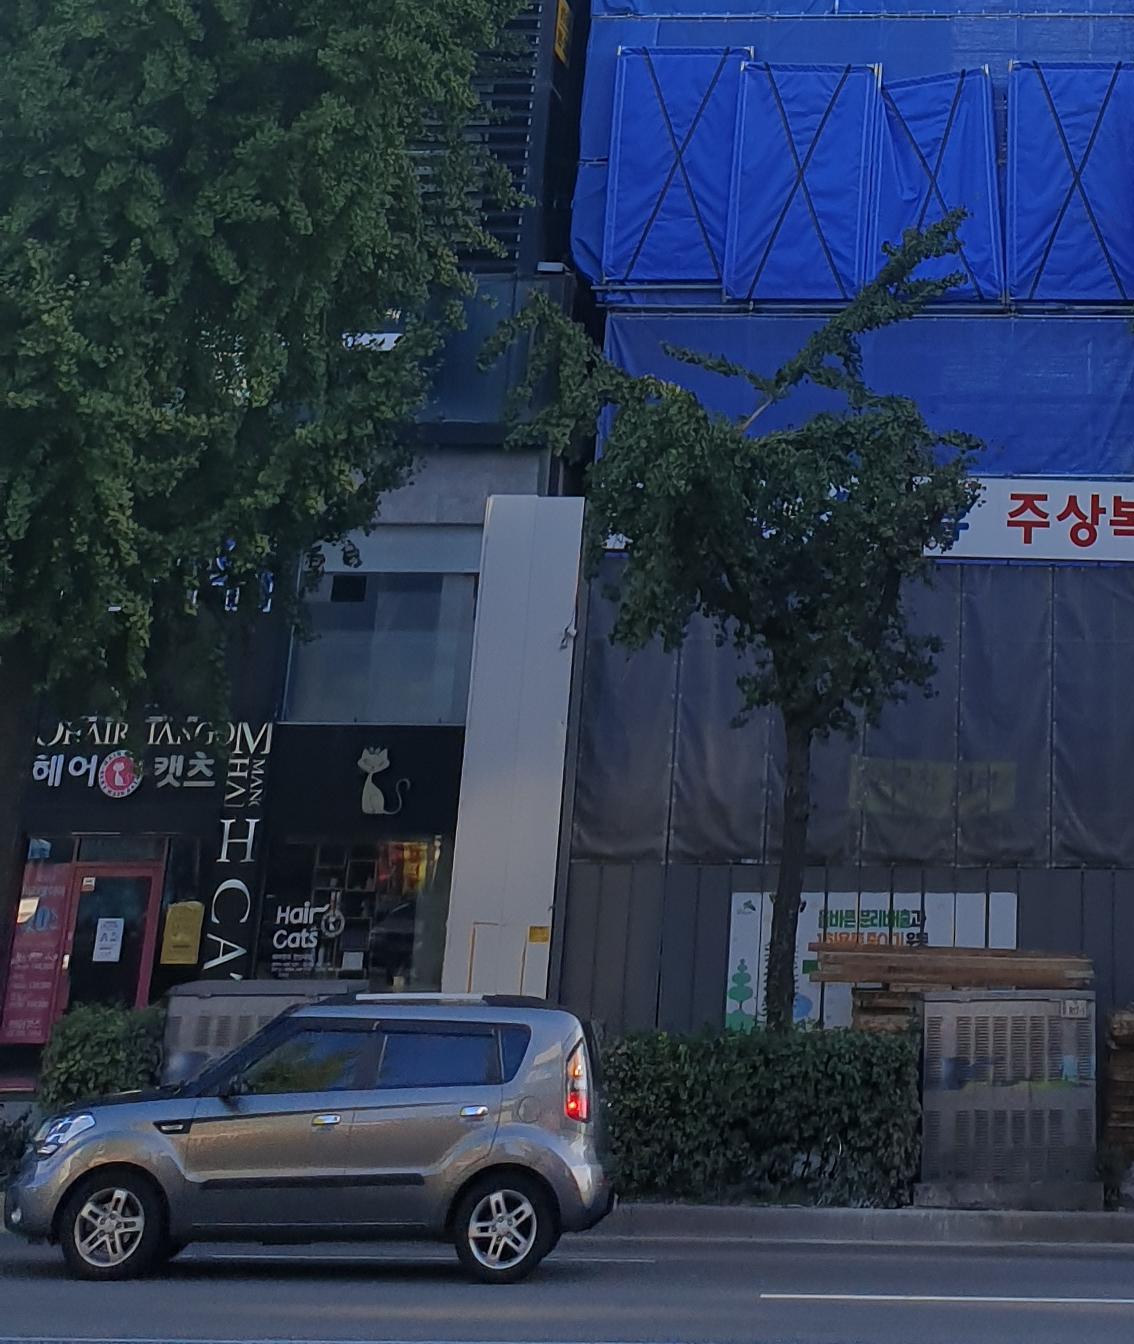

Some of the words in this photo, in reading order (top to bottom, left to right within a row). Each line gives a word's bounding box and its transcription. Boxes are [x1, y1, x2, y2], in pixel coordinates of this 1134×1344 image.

[33, 753, 99, 787] 헤어
[154, 751, 216, 787] 캣츠
[276, 901, 331, 925] Hair
